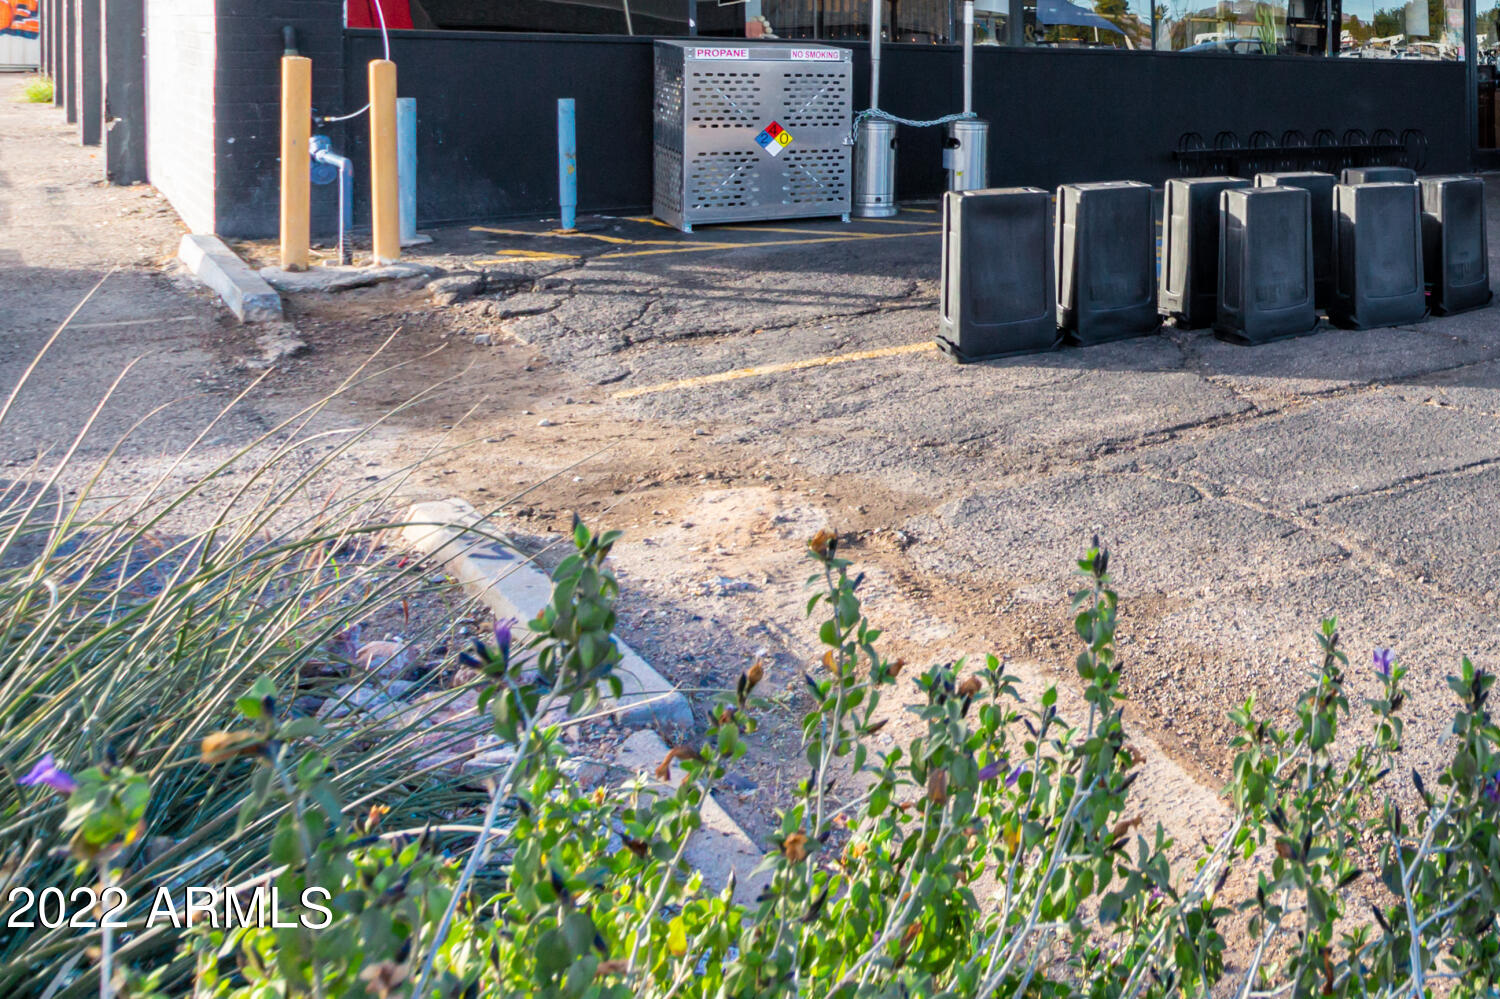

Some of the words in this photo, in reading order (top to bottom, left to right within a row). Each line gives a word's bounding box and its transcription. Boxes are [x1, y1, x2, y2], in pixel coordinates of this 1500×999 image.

[696, 48, 748, 58] PROPANE
[792, 50, 803, 59] NO
[804, 50, 839, 60] SMOKING
[767, 124, 777, 136] 4
[760, 133, 769, 144] 2
[779, 132, 789, 145] 0
